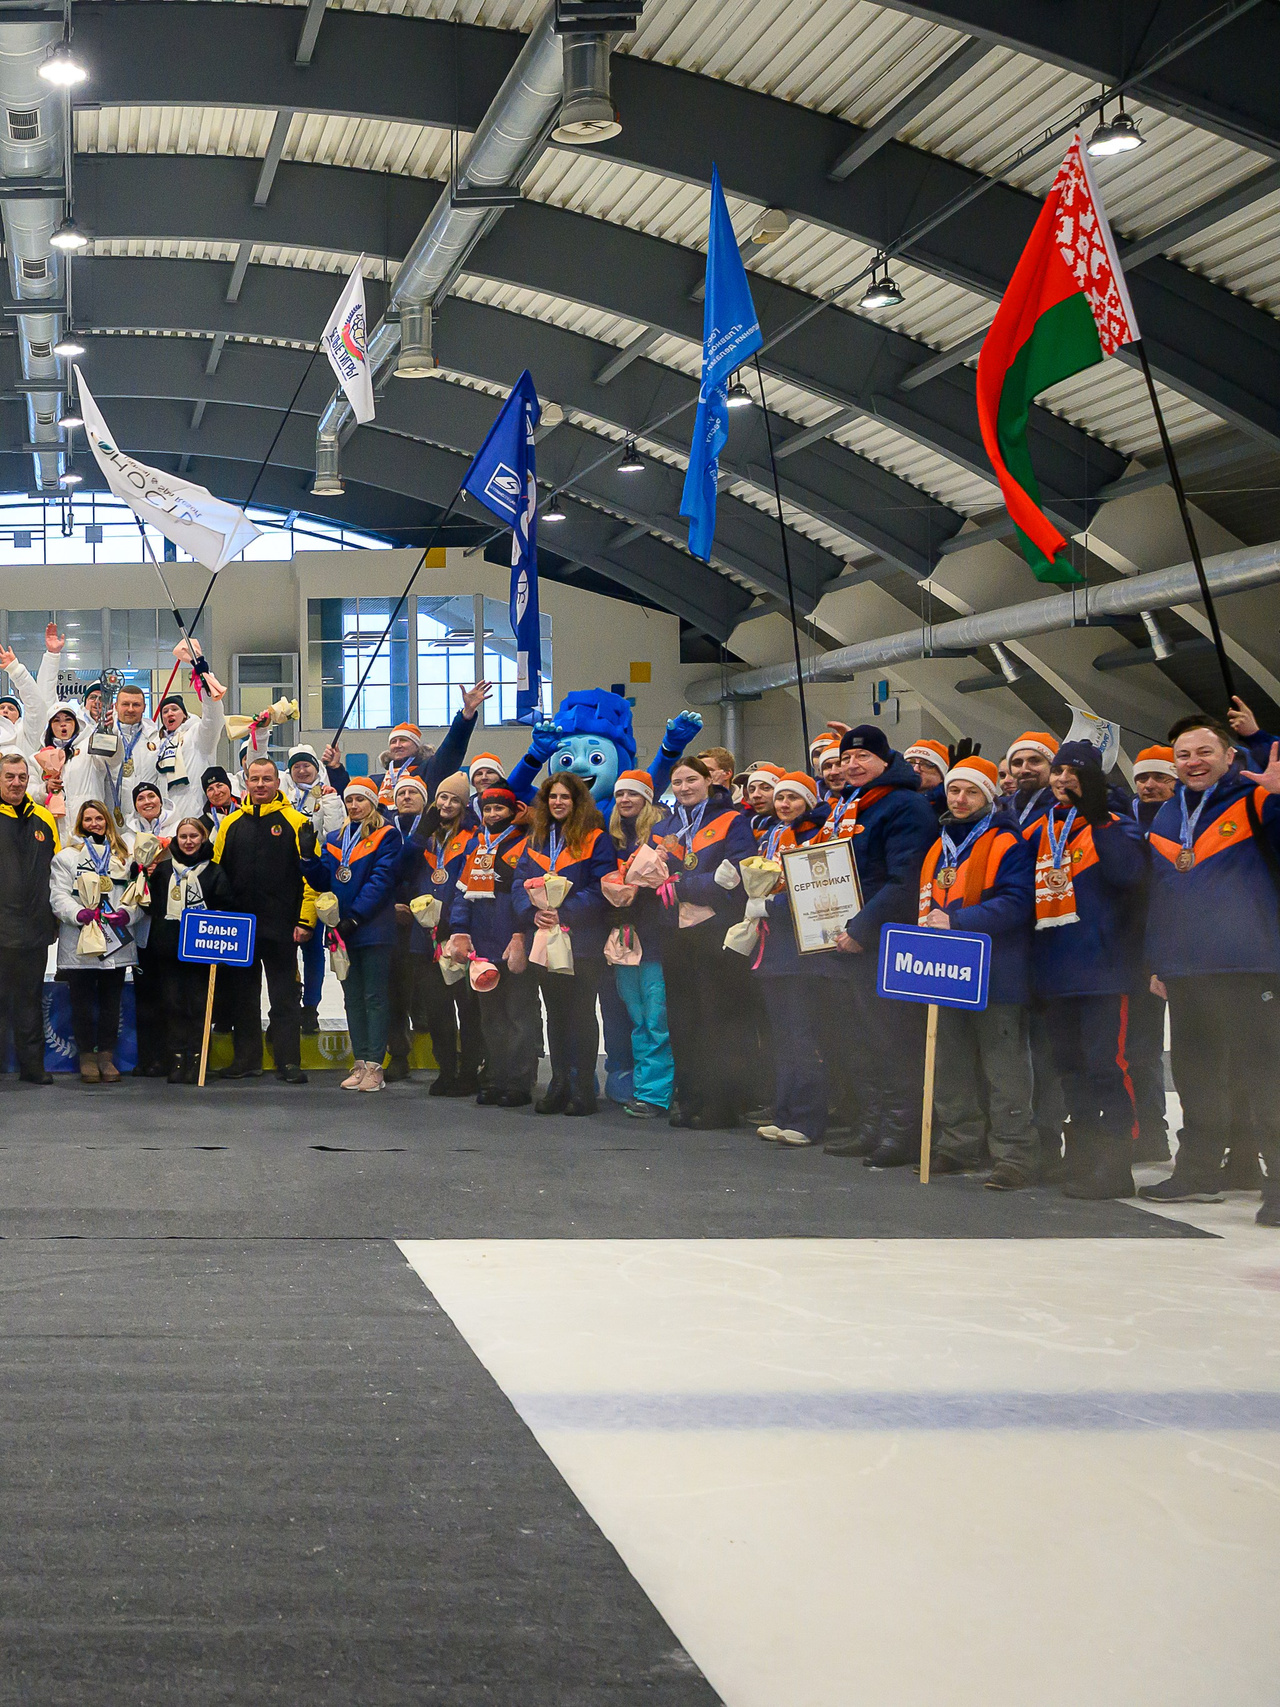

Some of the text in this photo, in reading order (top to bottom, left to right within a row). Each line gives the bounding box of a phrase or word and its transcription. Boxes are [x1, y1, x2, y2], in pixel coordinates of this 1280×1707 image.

[339, 350, 359, 380] ТИГРЫ
[794, 874, 851, 892] СЕРТИФИКАТ
[198, 920, 238, 937] Белые
[194, 938, 239, 955] тигры
[895, 952, 972, 982] Молния
